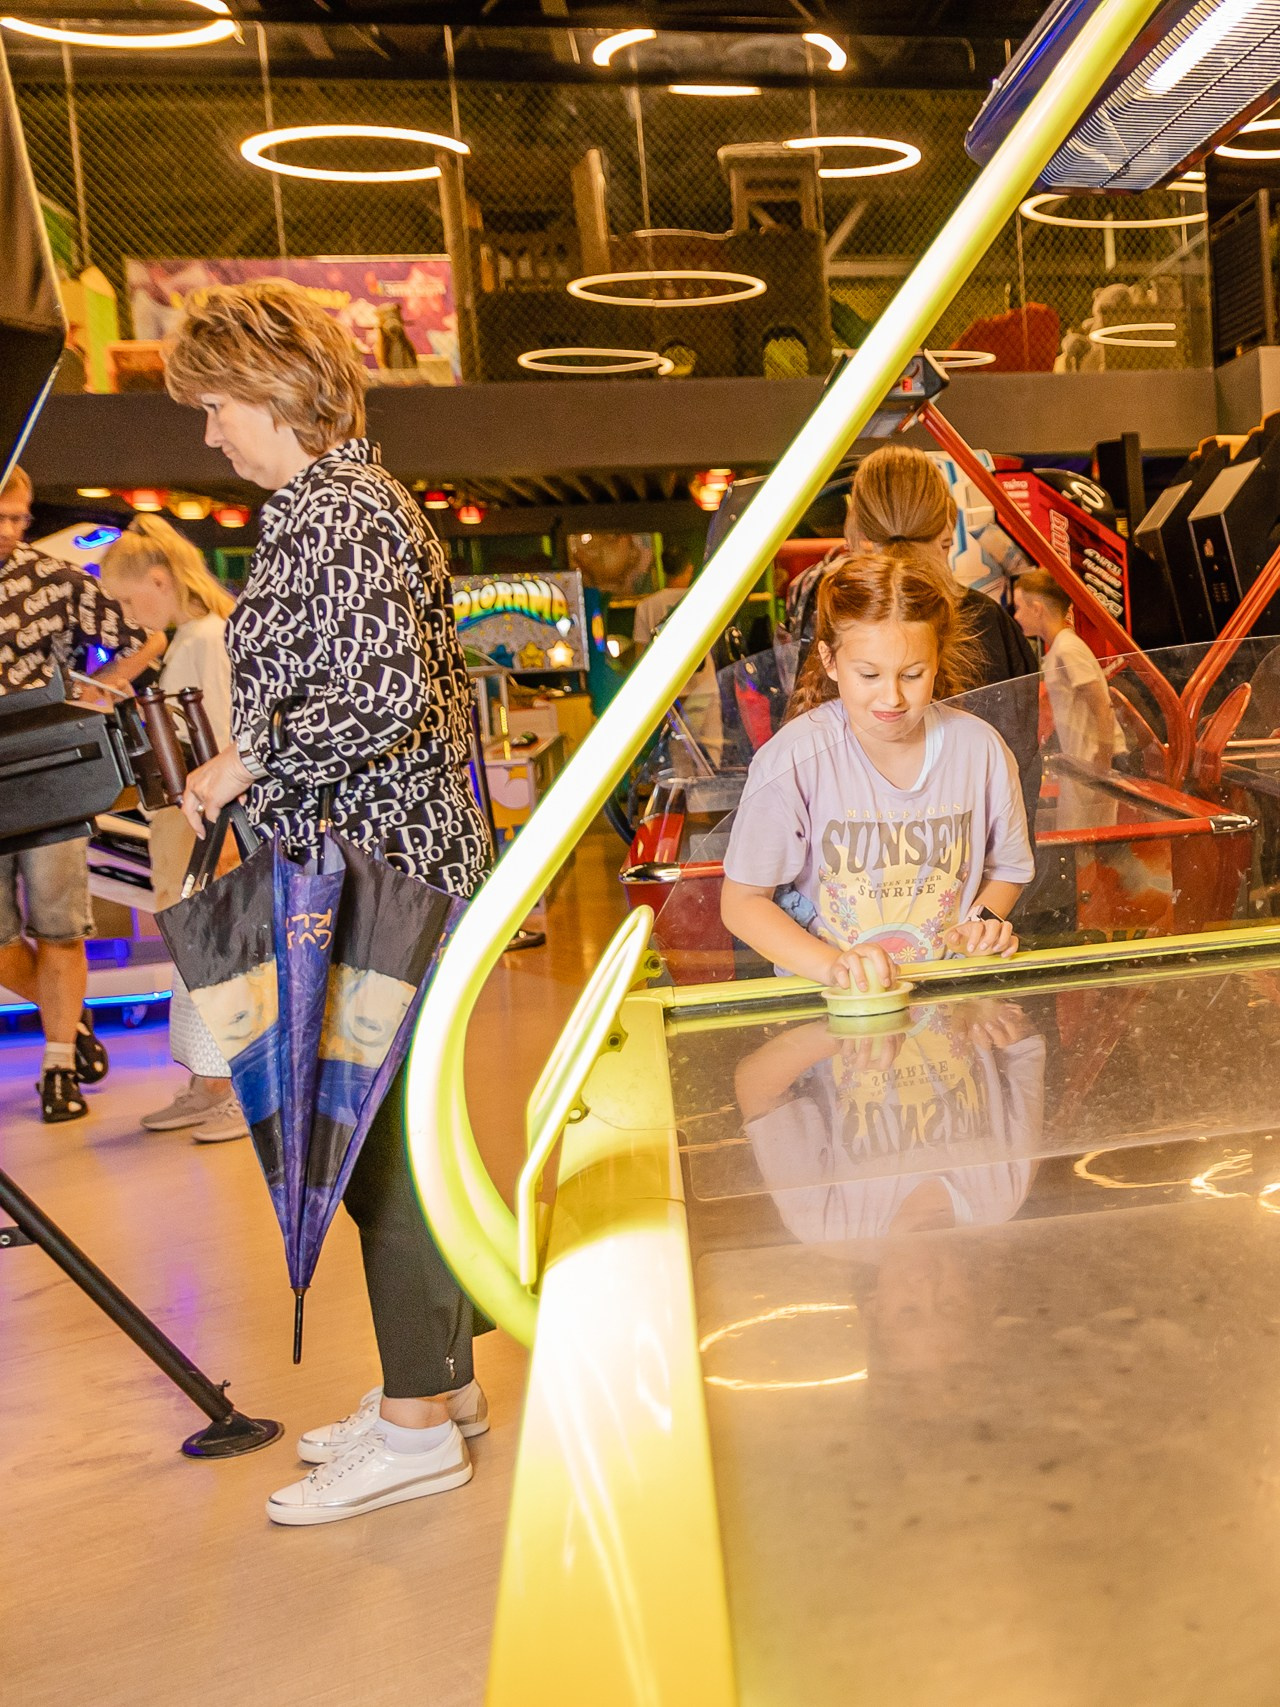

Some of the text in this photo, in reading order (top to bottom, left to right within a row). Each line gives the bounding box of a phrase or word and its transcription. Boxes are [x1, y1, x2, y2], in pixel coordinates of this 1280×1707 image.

[323, 565, 377, 621] Dior
[349, 541, 400, 599] Dior
[234, 604, 276, 660] Dior
[262, 596, 312, 648] Dior
[310, 594, 349, 652] Dior
[351, 612, 408, 666] Dior
[383, 597, 420, 655] Dior
[252, 655, 300, 708] Dior
[375, 664, 425, 718] Dior
[315, 712, 375, 757] Dior
[396, 824, 451, 875] Dior
[424, 799, 463, 850] Dior
[456, 834, 488, 882] Dior
[855, 875, 942, 889] AND EVEN BETTER
[858, 884, 936, 899] SUNRISE
